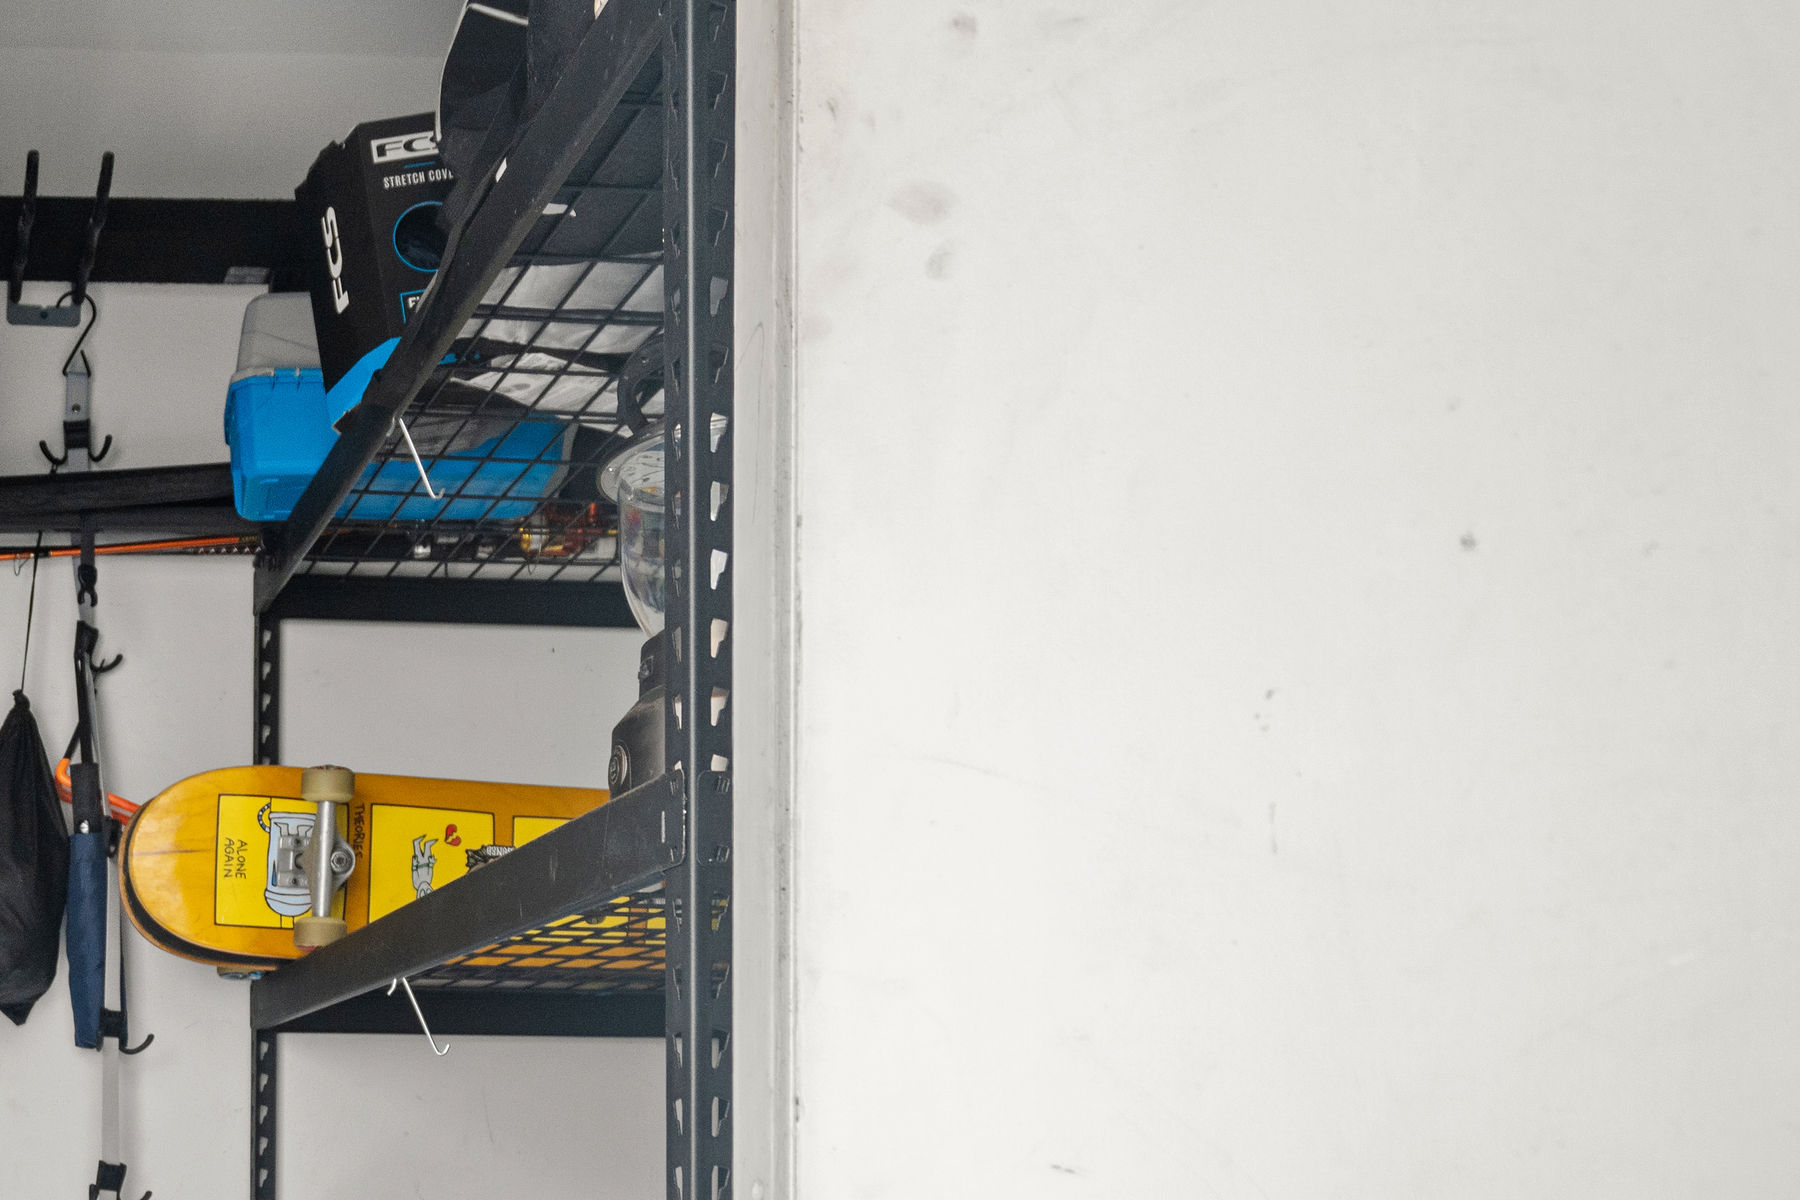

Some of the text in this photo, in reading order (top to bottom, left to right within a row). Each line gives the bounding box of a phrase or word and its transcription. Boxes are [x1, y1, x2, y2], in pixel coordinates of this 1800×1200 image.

[383, 171, 425, 190] STRETCH
[321, 206, 350, 314] FCS
[353, 803, 365, 858] THEORIES
[224, 837, 235, 878] AGAIN
[235, 839, 248, 879] ALONE
